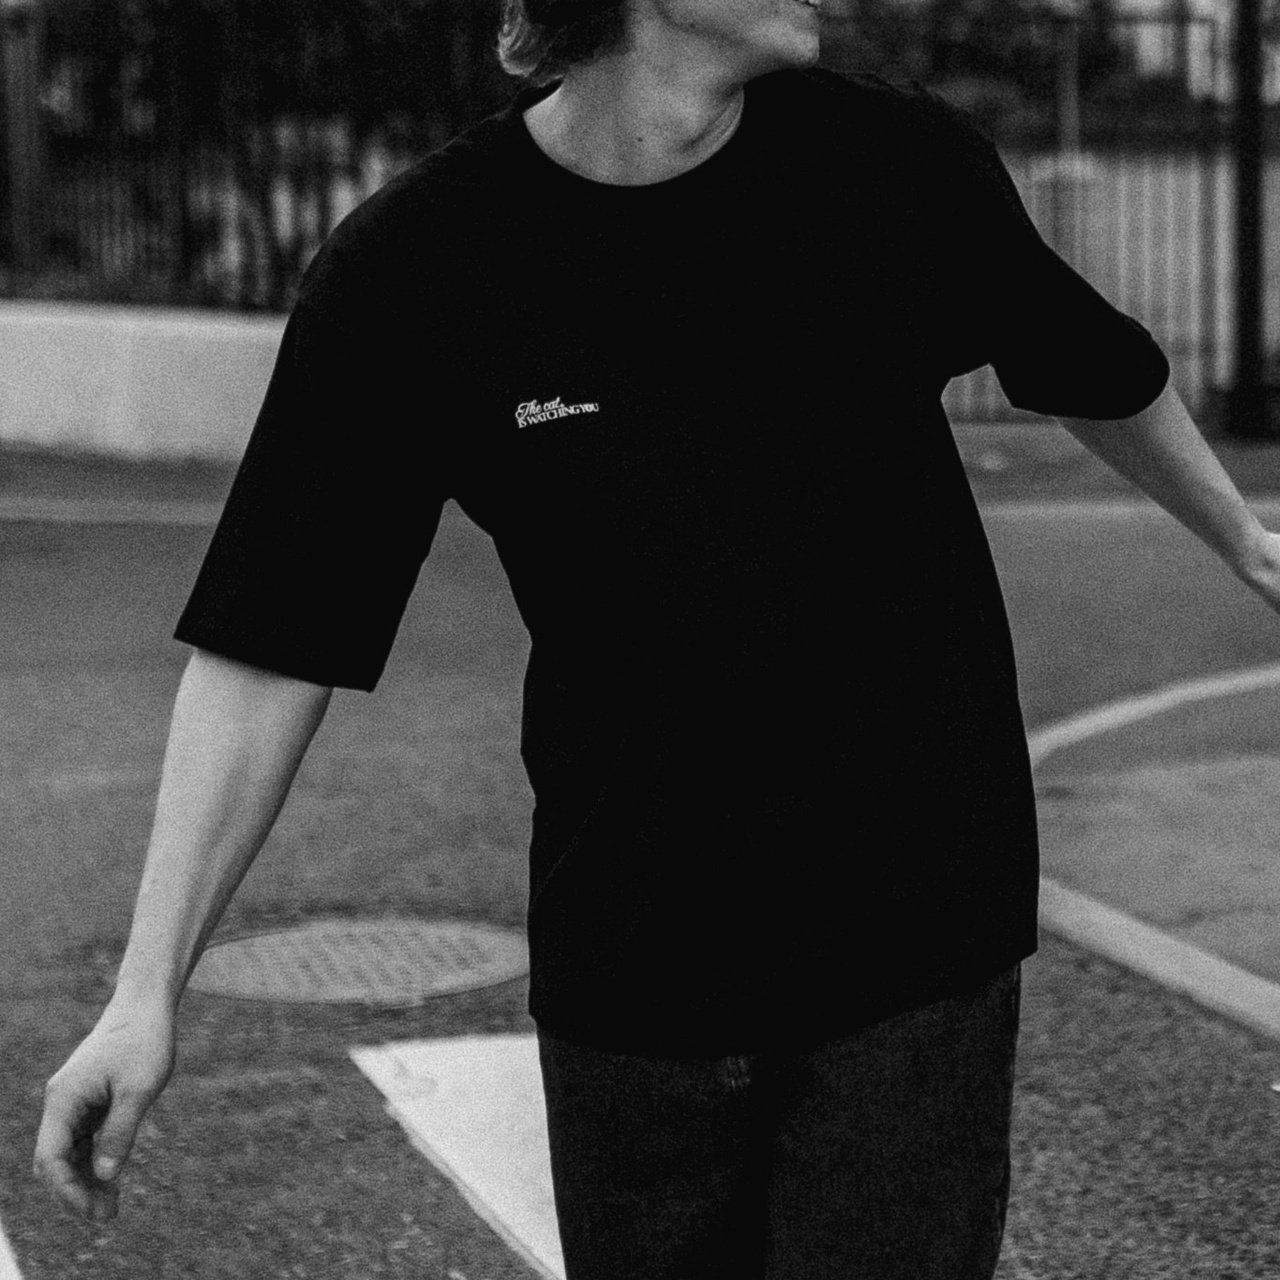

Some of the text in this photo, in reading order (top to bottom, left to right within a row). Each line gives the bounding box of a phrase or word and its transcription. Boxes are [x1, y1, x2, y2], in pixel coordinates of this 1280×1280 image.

[515, 399, 542, 419] The
[517, 402, 600, 429] IS WATCHING YOU
